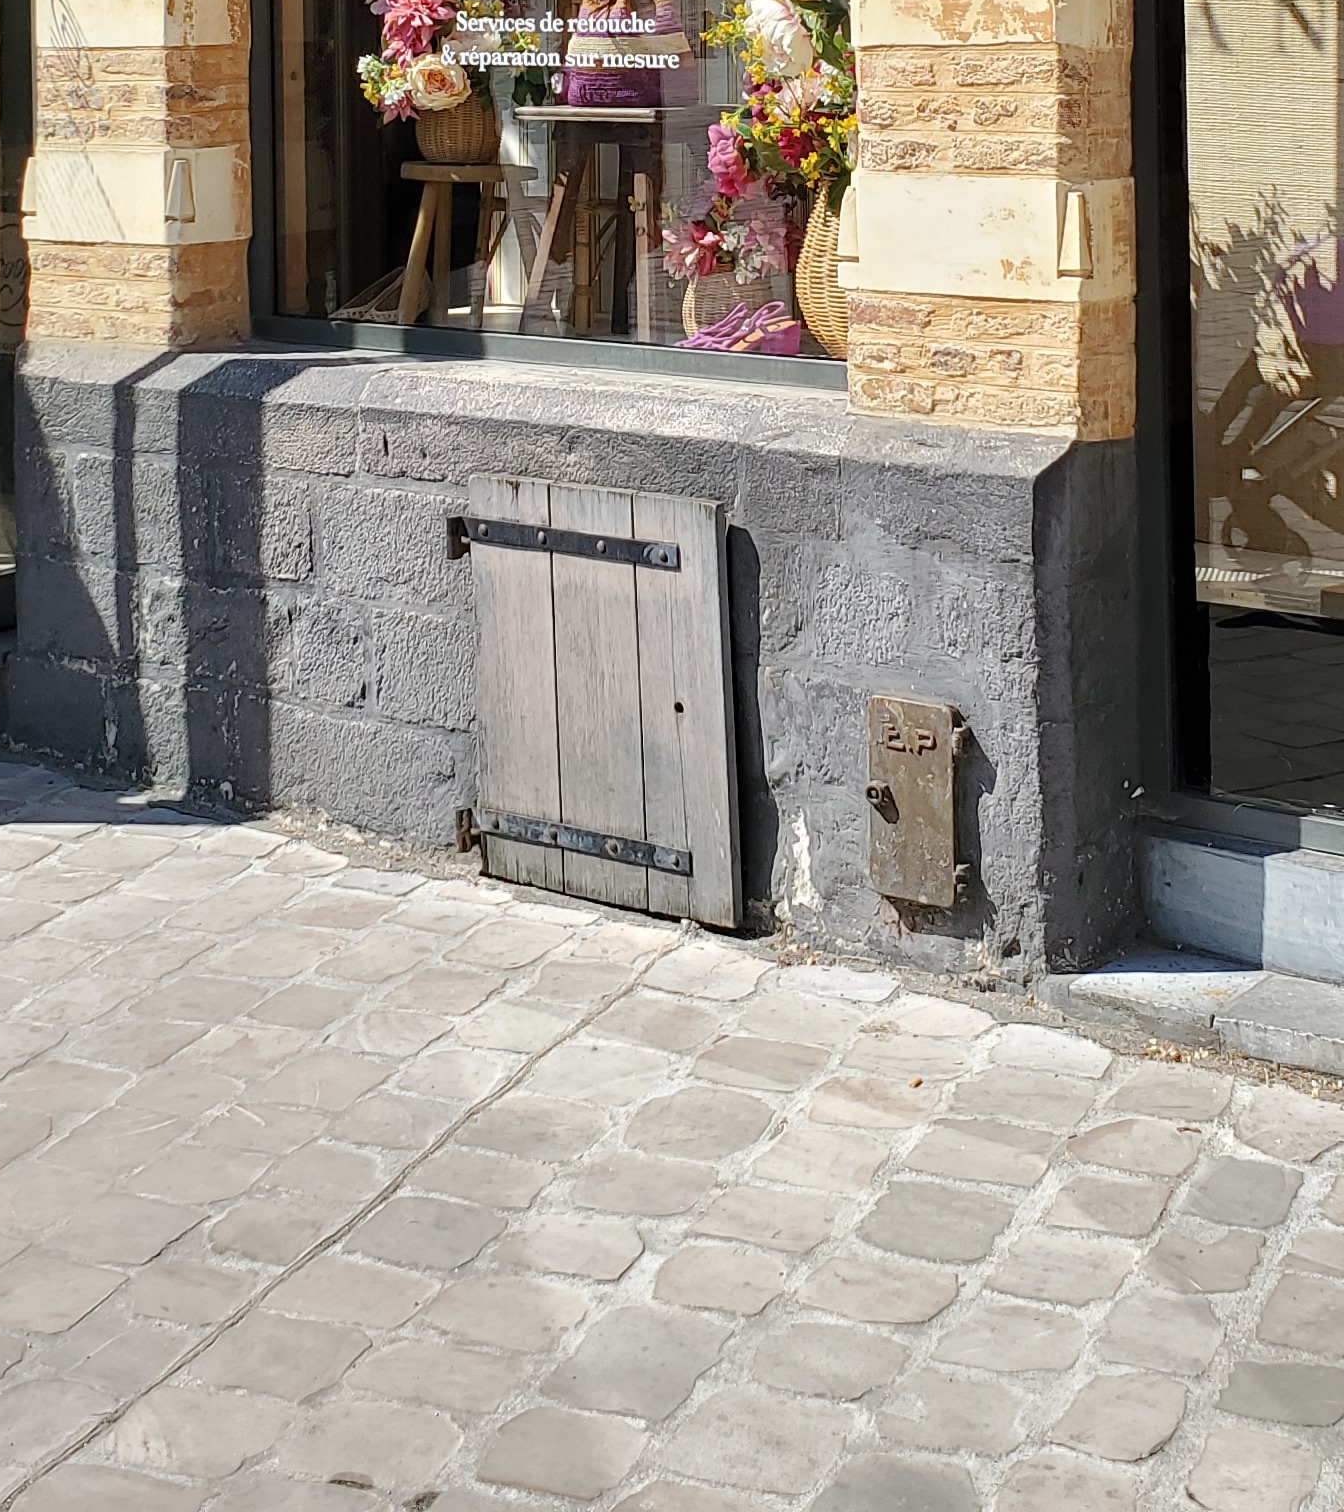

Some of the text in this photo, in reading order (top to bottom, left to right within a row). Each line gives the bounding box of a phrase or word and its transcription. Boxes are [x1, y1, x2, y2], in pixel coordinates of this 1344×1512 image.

[456, 11, 656, 33] Services de retouche
[440, 45, 680, 72] & réparation sur mesure
